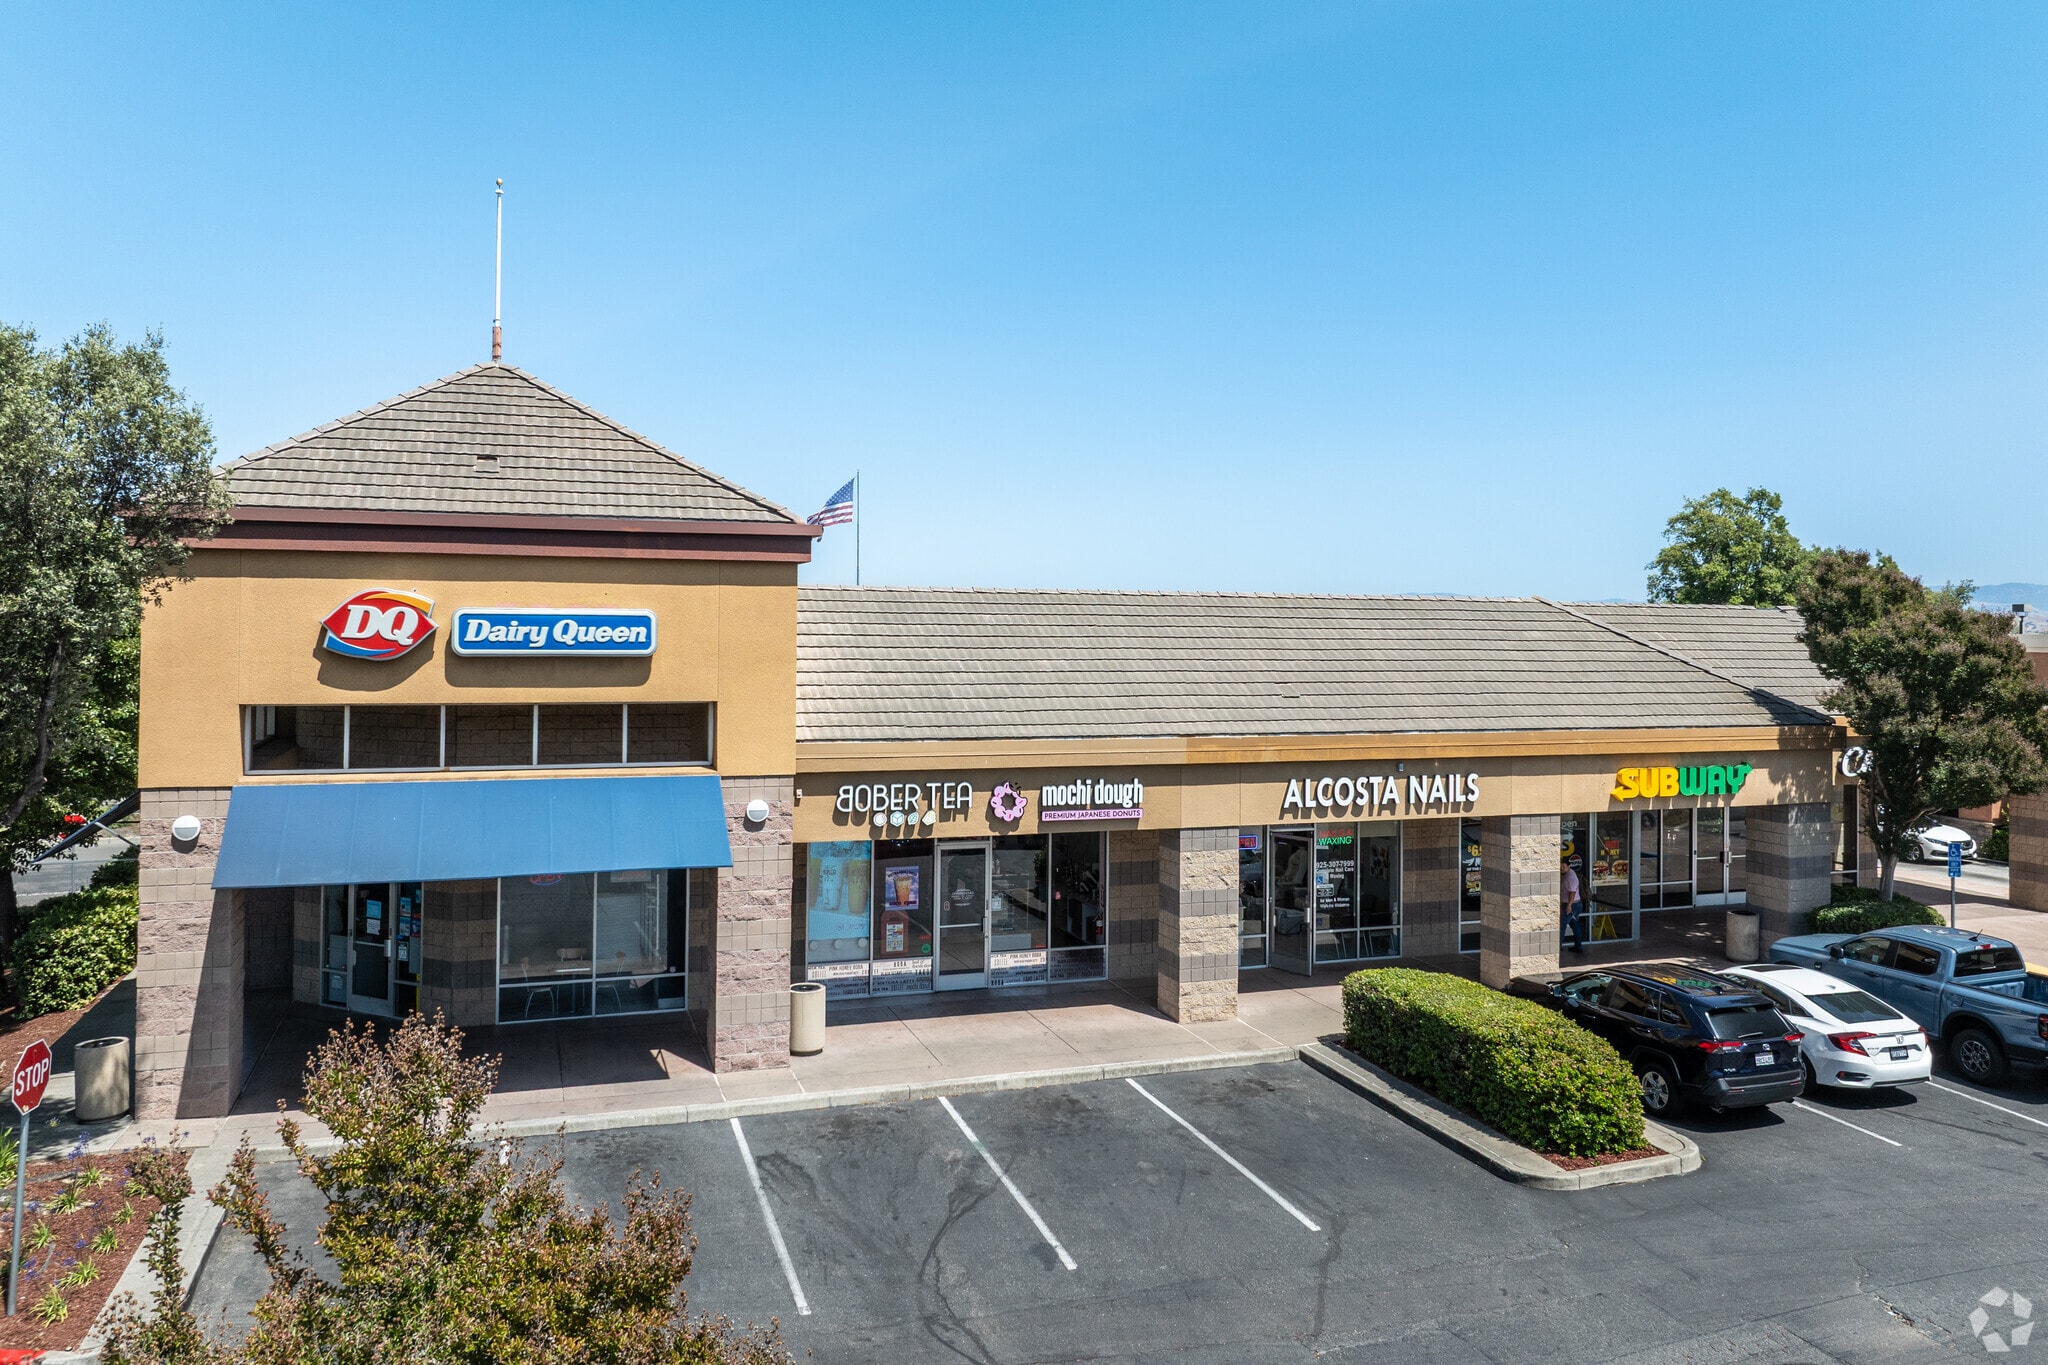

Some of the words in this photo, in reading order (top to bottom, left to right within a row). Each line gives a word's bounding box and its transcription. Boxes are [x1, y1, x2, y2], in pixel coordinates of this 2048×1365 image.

[342, 605, 419, 645] DQ
[464, 619, 550, 648] Dairy
[552, 620, 646, 644] Queen
[926, 781, 973, 809] TEA
[1041, 779, 1092, 807] mochi
[1094, 777, 1144, 808] dough
[1283, 776, 1400, 809] ALCOSTA
[1409, 773, 1480, 804] NAILS
[1610, 762, 1753, 802] SUBWAY
[1044, 811, 1076, 820] PREMIUM
[1078, 810, 1111, 819] JAPANESE
[1113, 809, 1142, 818] DONUTS
[1561, 820, 1578, 830] pen
[1239, 837, 1256, 849] PEN
[1318, 836, 1352, 846] WAXING
[15, 1058, 49, 1096] STOP
